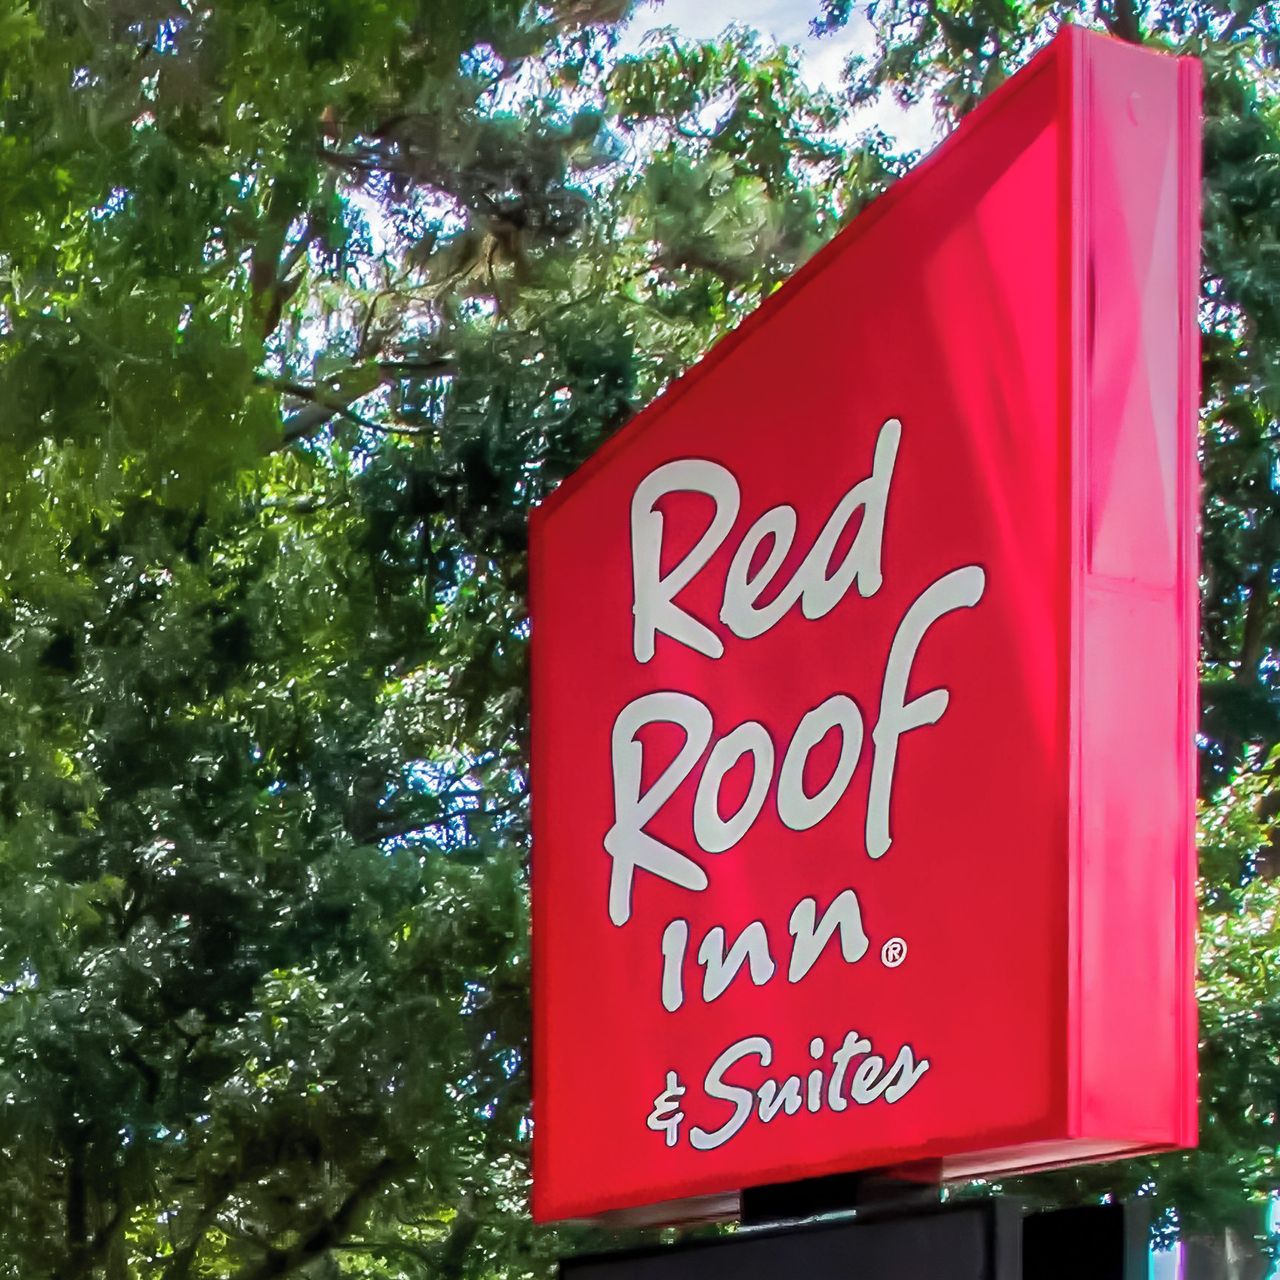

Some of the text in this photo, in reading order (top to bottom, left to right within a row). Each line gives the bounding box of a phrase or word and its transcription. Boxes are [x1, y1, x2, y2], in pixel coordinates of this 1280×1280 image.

[630, 418, 902, 663] Red
[603, 565, 986, 927] Roof
[646, 1030, 930, 1150] & Suites
